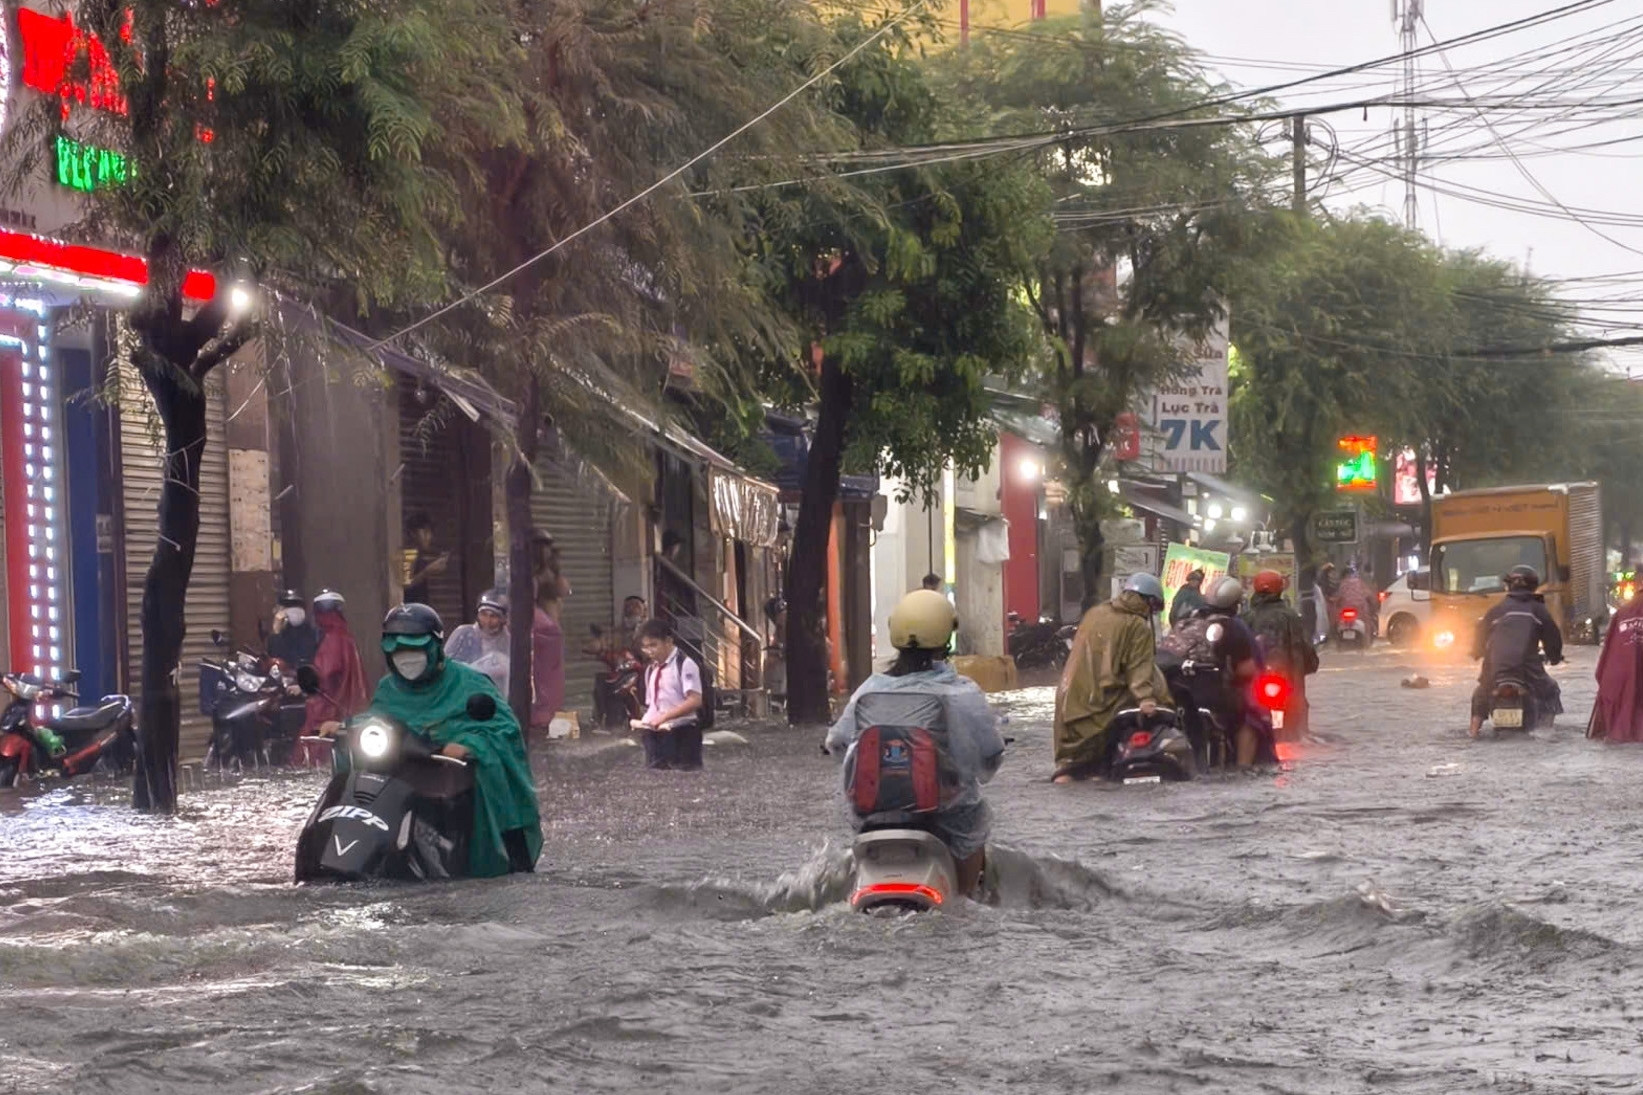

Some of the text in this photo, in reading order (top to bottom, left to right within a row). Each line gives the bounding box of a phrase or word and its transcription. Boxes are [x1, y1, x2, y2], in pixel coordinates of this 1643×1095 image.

[1162, 402, 1219, 416] Lục Trà
[1160, 419, 1222, 451] 7K
